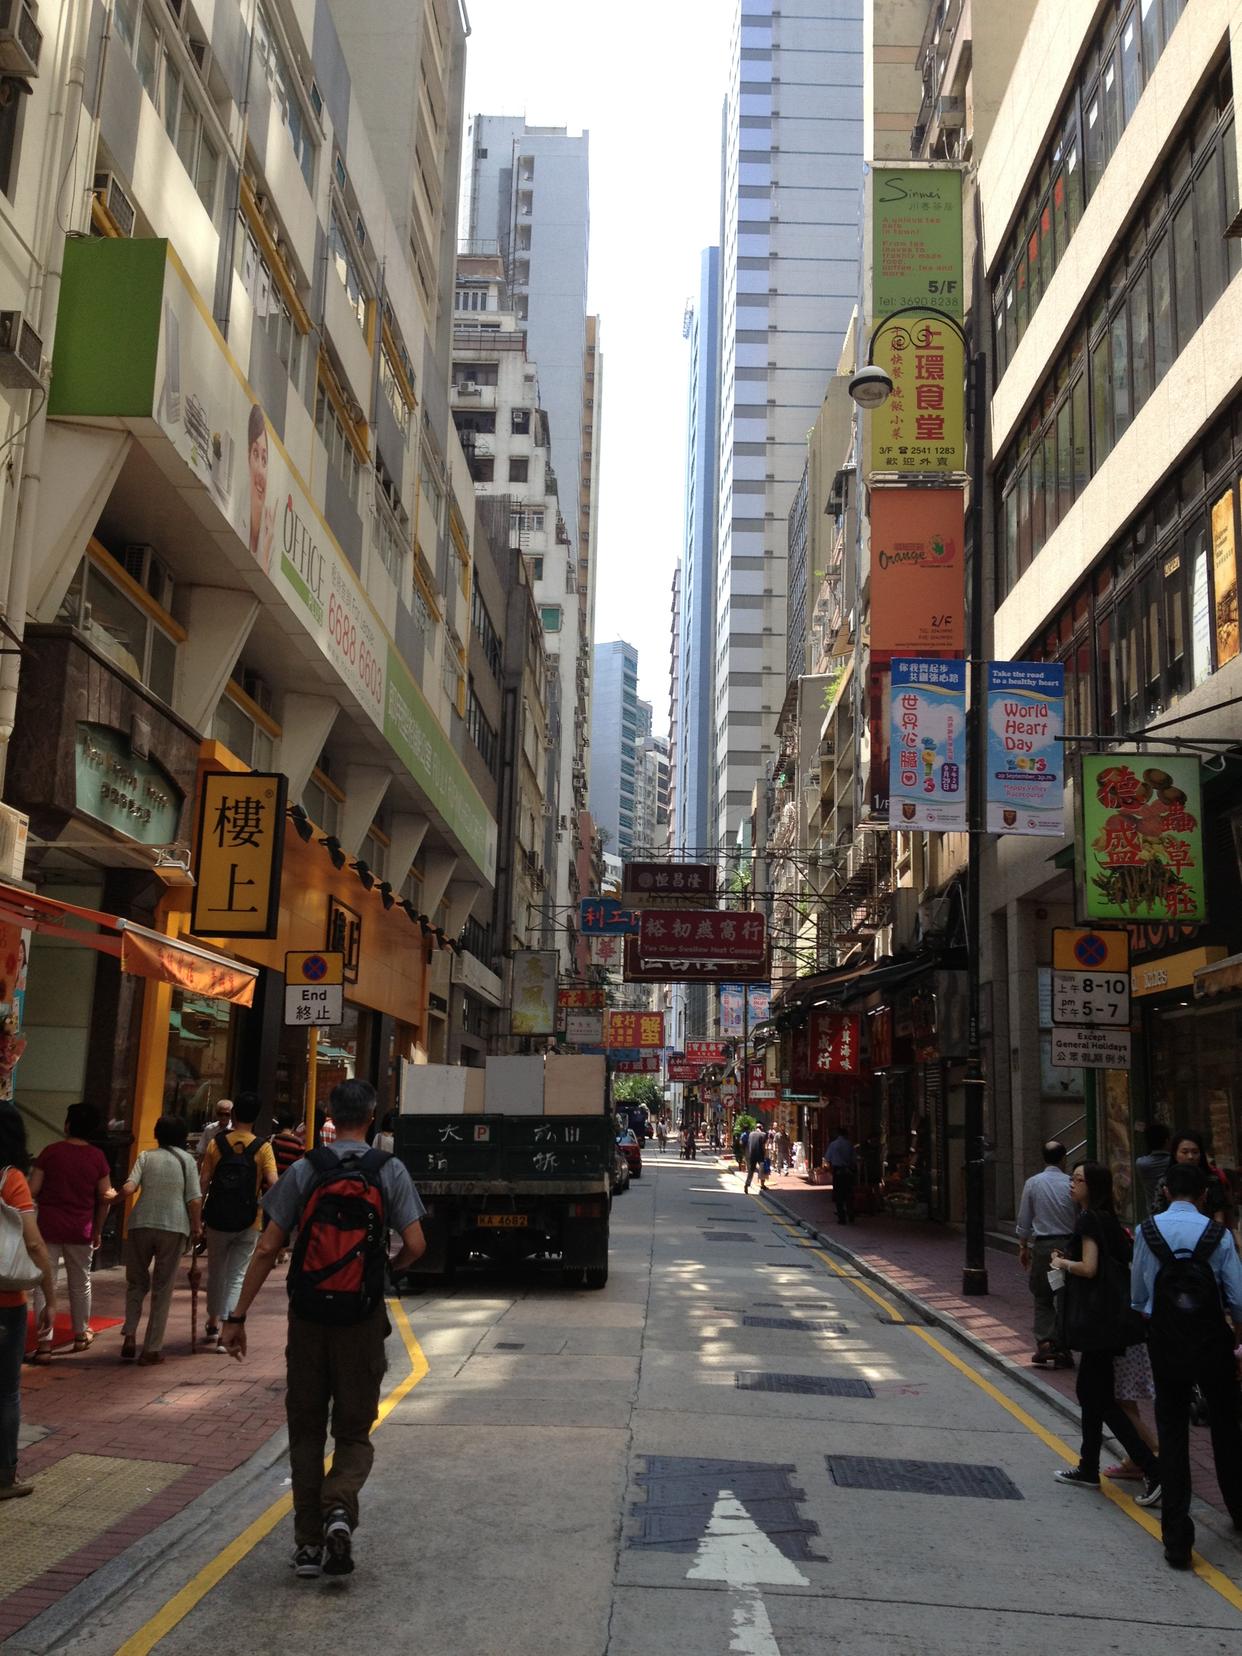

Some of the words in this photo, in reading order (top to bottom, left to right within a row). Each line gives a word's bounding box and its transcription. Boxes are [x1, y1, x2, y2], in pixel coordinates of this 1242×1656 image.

[928, 281, 957, 295] 5/F
[901, 297, 928, 307] 3690
[930, 297, 958, 307] 8238
[915, 324, 945, 440] 上環食堂
[880, 447, 893, 455] 3/F
[911, 447, 931, 455] 2541
[935, 447, 956, 455] 1283
[886, 457, 948, 466] 歡迎外賣
[283, 501, 327, 606] OFFICE
[932, 615, 952, 627] 2/F
[328, 592, 356, 666] 6688
[358, 640, 383, 705] 6603
[993, 670, 1012, 678] Take
[1008, 678, 1037, 687] healthy
[1038, 679, 1059, 687] heart
[1004, 703, 1048, 718] World
[1005, 719, 1048, 736] Heart
[901, 694, 918, 787] 世界心臟日
[1005, 736, 1033, 752] Day
[1006, 757, 1047, 772] 2013
[1096, 765, 1148, 869] 德盛
[208, 795, 265, 912] 樓上
[645, 918, 762, 942] 裕初燕窩行
[1057, 983, 1079, 994] 上午
[1082, 978, 1125, 994] 8-10
[302, 990, 327, 1000] End
[1062, 999, 1075, 1007] pm
[296, 1005, 330, 1021] 終止
[1058, 1007, 1079, 1018] 下午
[1077, 1033, 1106, 1042] Except
[1056, 1041, 1089, 1049] General
[1091, 1042, 1127, 1052] Holidays
[1057, 1051, 1127, 1064] 公眾假期例外
[438, 1123, 464, 1142] 大
[477, 1126, 488, 1140] P
